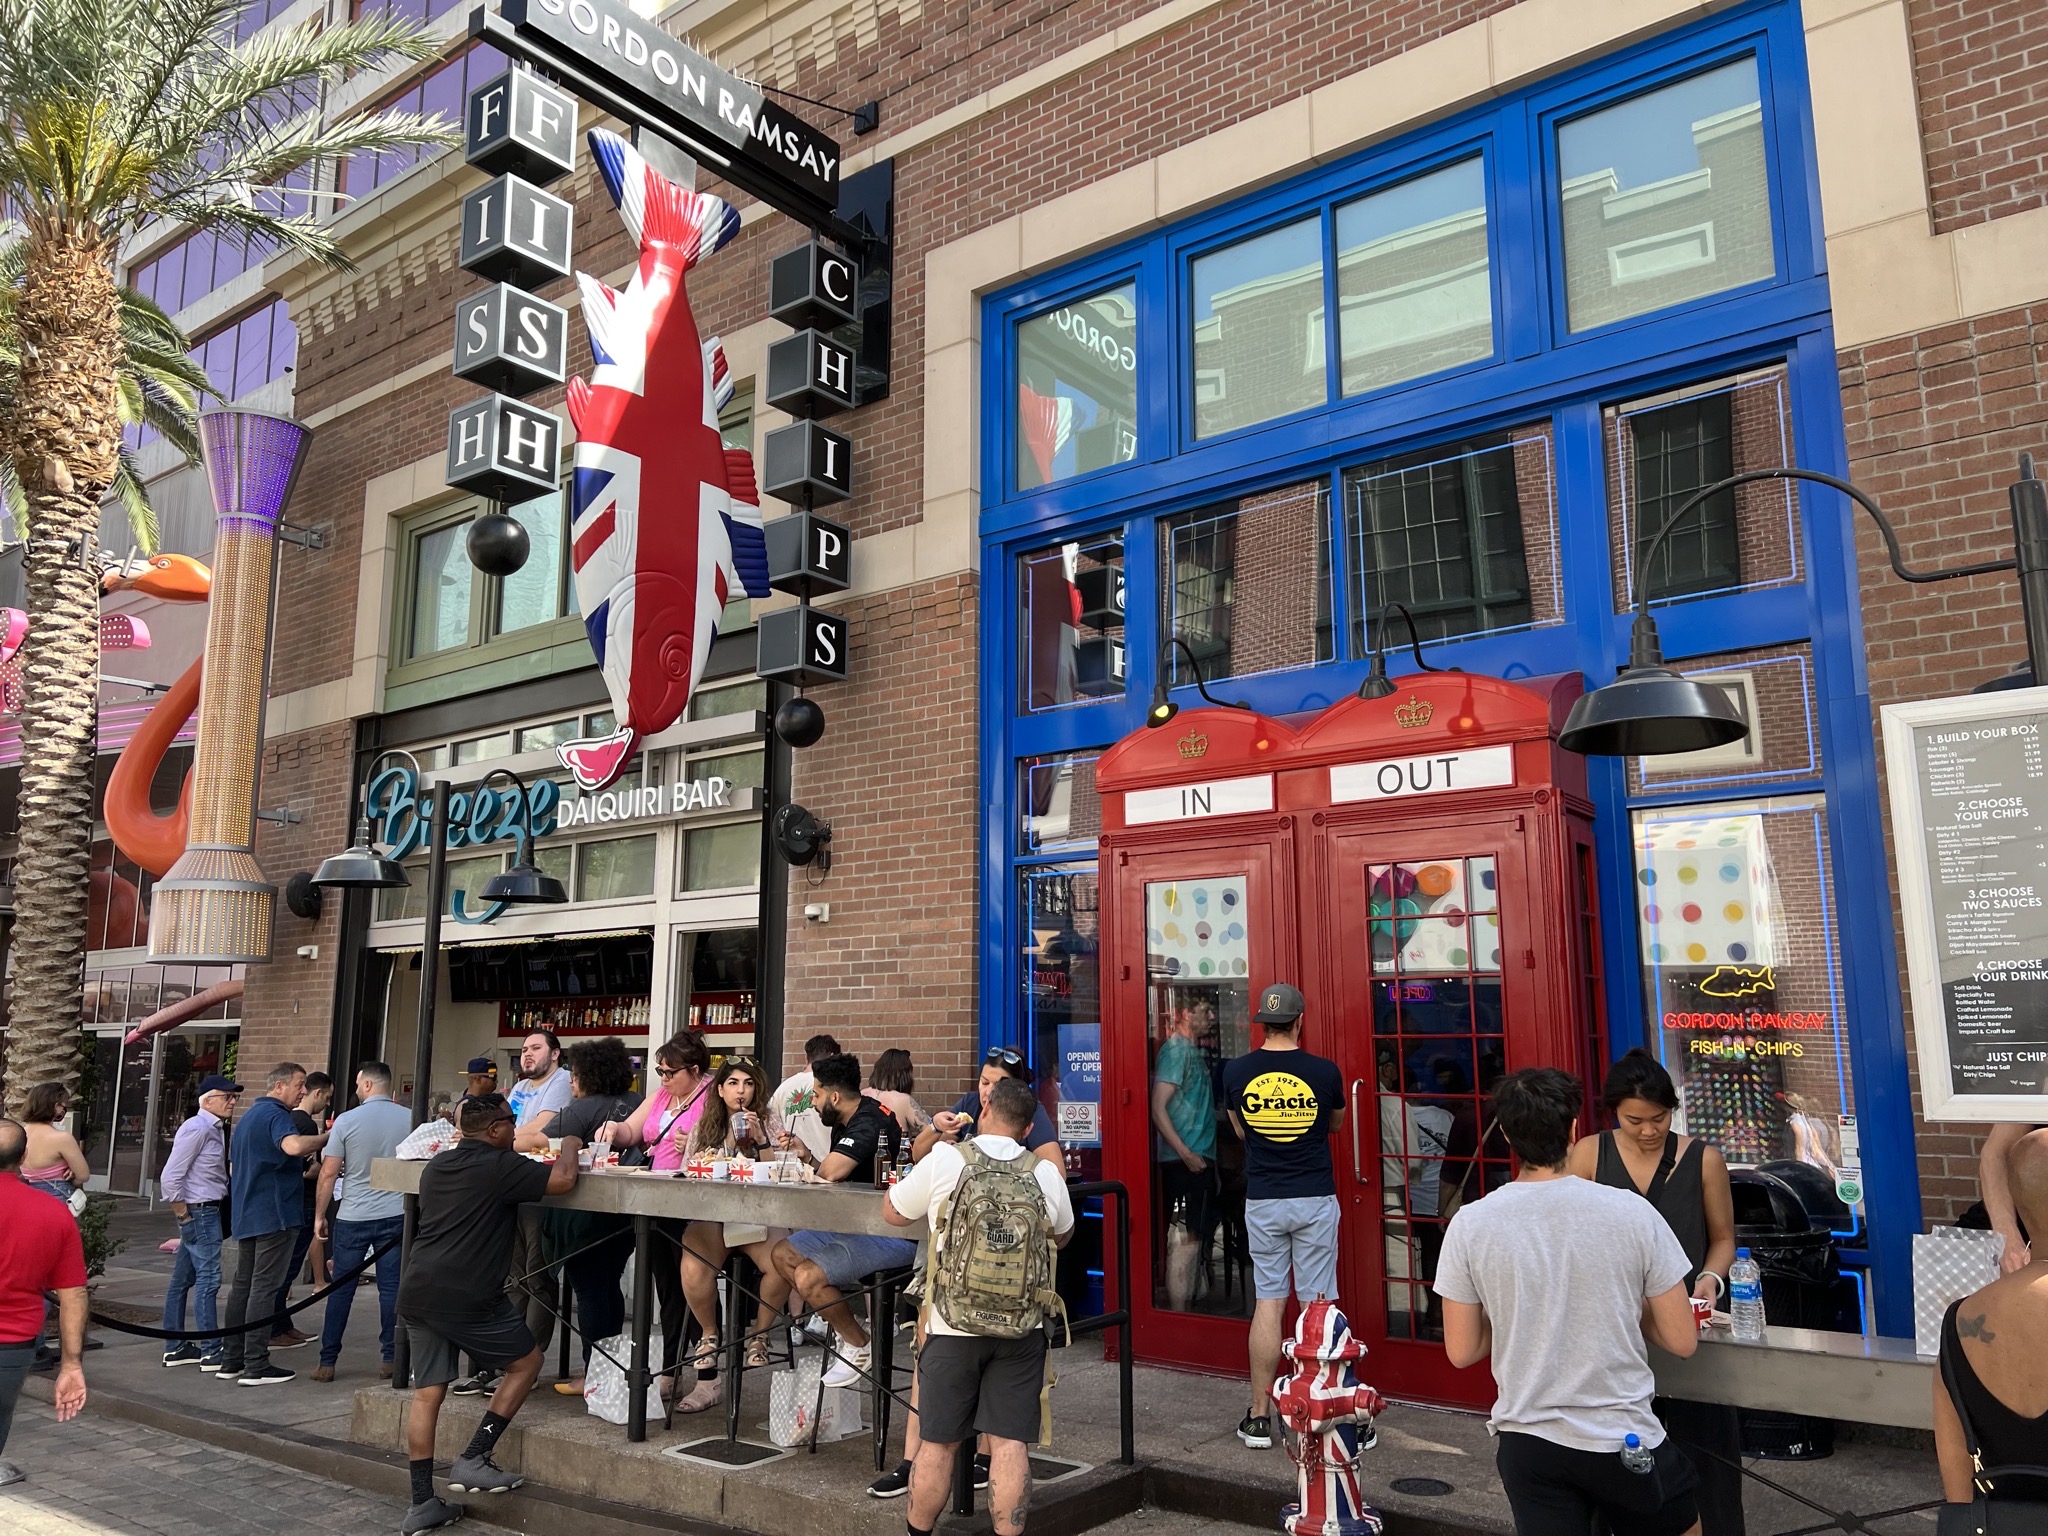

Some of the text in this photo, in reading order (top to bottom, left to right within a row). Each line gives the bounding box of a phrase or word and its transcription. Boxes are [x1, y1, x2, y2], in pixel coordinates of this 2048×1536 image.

[718, 88, 837, 183] RAMSAY
[503, 89, 564, 474] FISH
[814, 259, 850, 667] CHIPS
[1973, 727, 2007, 739] YOUR
[2011, 724, 2038, 736] BOX
[1376, 755, 1460, 795] OUT
[556, 776, 724, 829] DAIQUIRI BAR
[1181, 785, 1212, 817] IN
[1958, 797, 2023, 810] 2.CHOOSE
[1954, 808, 2029, 821] YOUR CHIPS
[1968, 887, 2034, 899] 3.CHOOSE
[1962, 897, 2042, 910] TWO SAUCES
[1976, 959, 2042, 970] 4.CHOOSE
[1972, 971, 2048, 982] YOUR DRINK
[1663, 1011, 1827, 1031] GORDON RAMSAY
[1690, 1040, 1724, 1055] FISH
[1755, 1041, 1804, 1058] CHIPS
[1066, 1052, 1100, 1062] OPENING
[1987, 1052, 2048, 1062] JUST CHIP
[1071, 1062, 1102, 1072] OF OPER
[1256, 1076, 1299, 1088] EST. 1925
[1241, 1092, 1318, 1114] Gracie
[987, 1232, 1014, 1244] GUARD
[975, 1311, 1008, 1323] FIGUEROA
